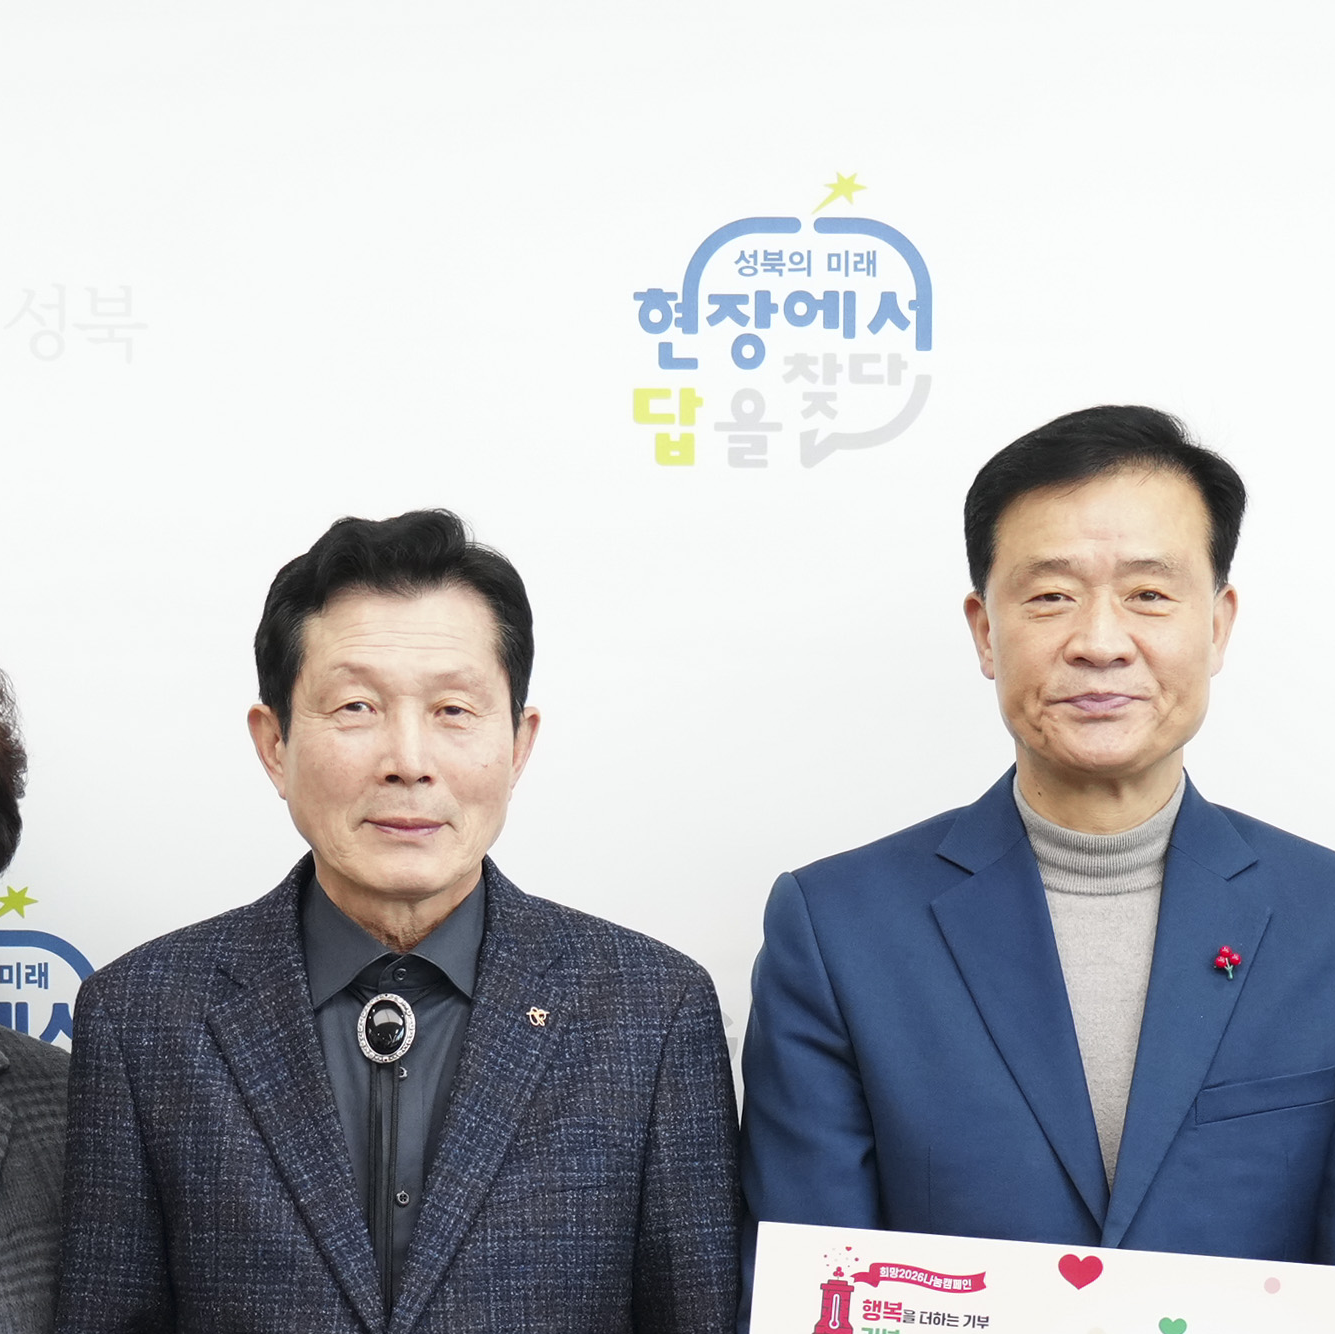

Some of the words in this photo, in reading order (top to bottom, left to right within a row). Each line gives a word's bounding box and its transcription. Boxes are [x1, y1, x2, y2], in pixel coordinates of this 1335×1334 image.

[734, 250, 812, 277] 성북의
[827, 250, 877, 278] 미래
[3, 282, 149, 365] 성북
[633, 288, 932, 370] 현장에서
[0, 962, 49, 990] 미래
[879, 1266, 972, 1290] 희망2026나눔캠페인
[862, 1299, 916, 1324] 행복을
[919, 1311, 959, 1328] 더하는
[963, 1314, 990, 1329] 기부
